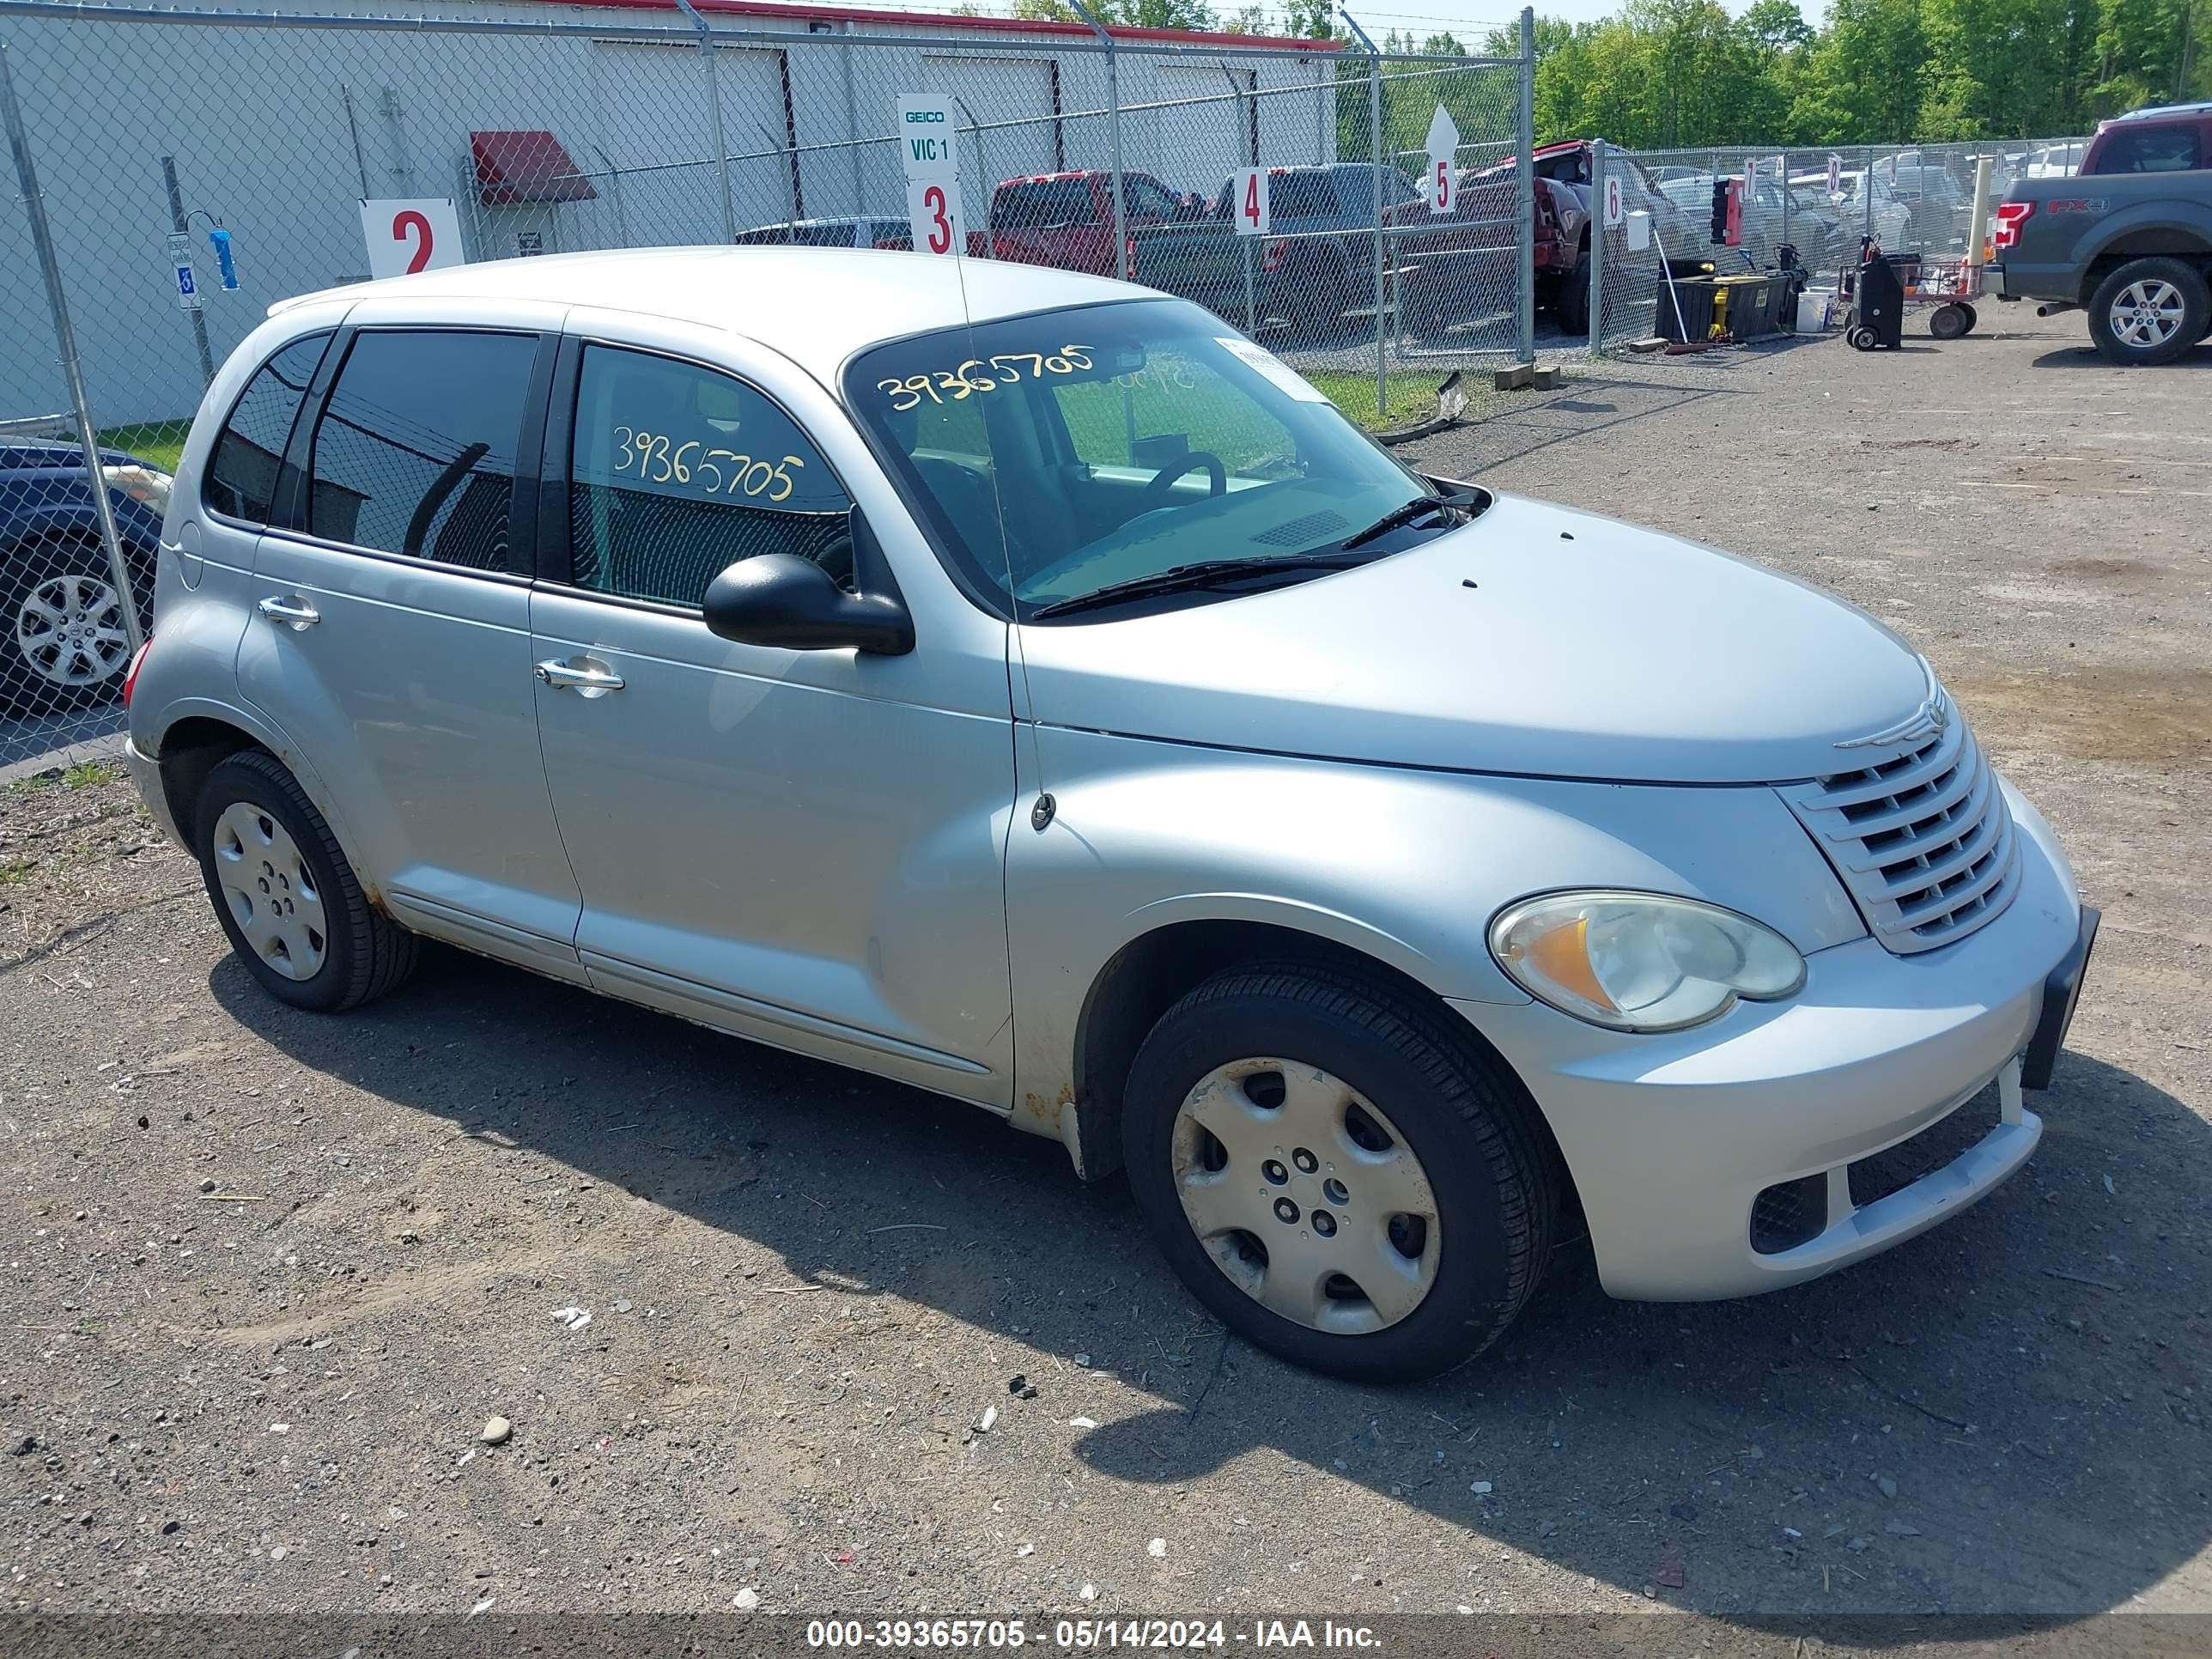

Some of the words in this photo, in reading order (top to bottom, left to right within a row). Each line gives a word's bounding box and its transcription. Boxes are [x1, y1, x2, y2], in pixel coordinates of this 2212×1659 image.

[906, 112, 945, 123] GEICO
[911, 138, 936, 161] VIC
[941, 138, 948, 161] 1
[1437, 161, 1449, 208] 5
[1747, 162, 1753, 194] 7
[1831, 161, 1837, 191] 8
[924, 185, 951, 254] 3
[1245, 173, 1260, 228] 4
[1609, 179, 1619, 220] 6
[2047, 198, 2109, 214] FX4
[392, 210, 433, 275] 2
[877, 344, 1095, 411] 39365705
[614, 426, 805, 501] 39365705
